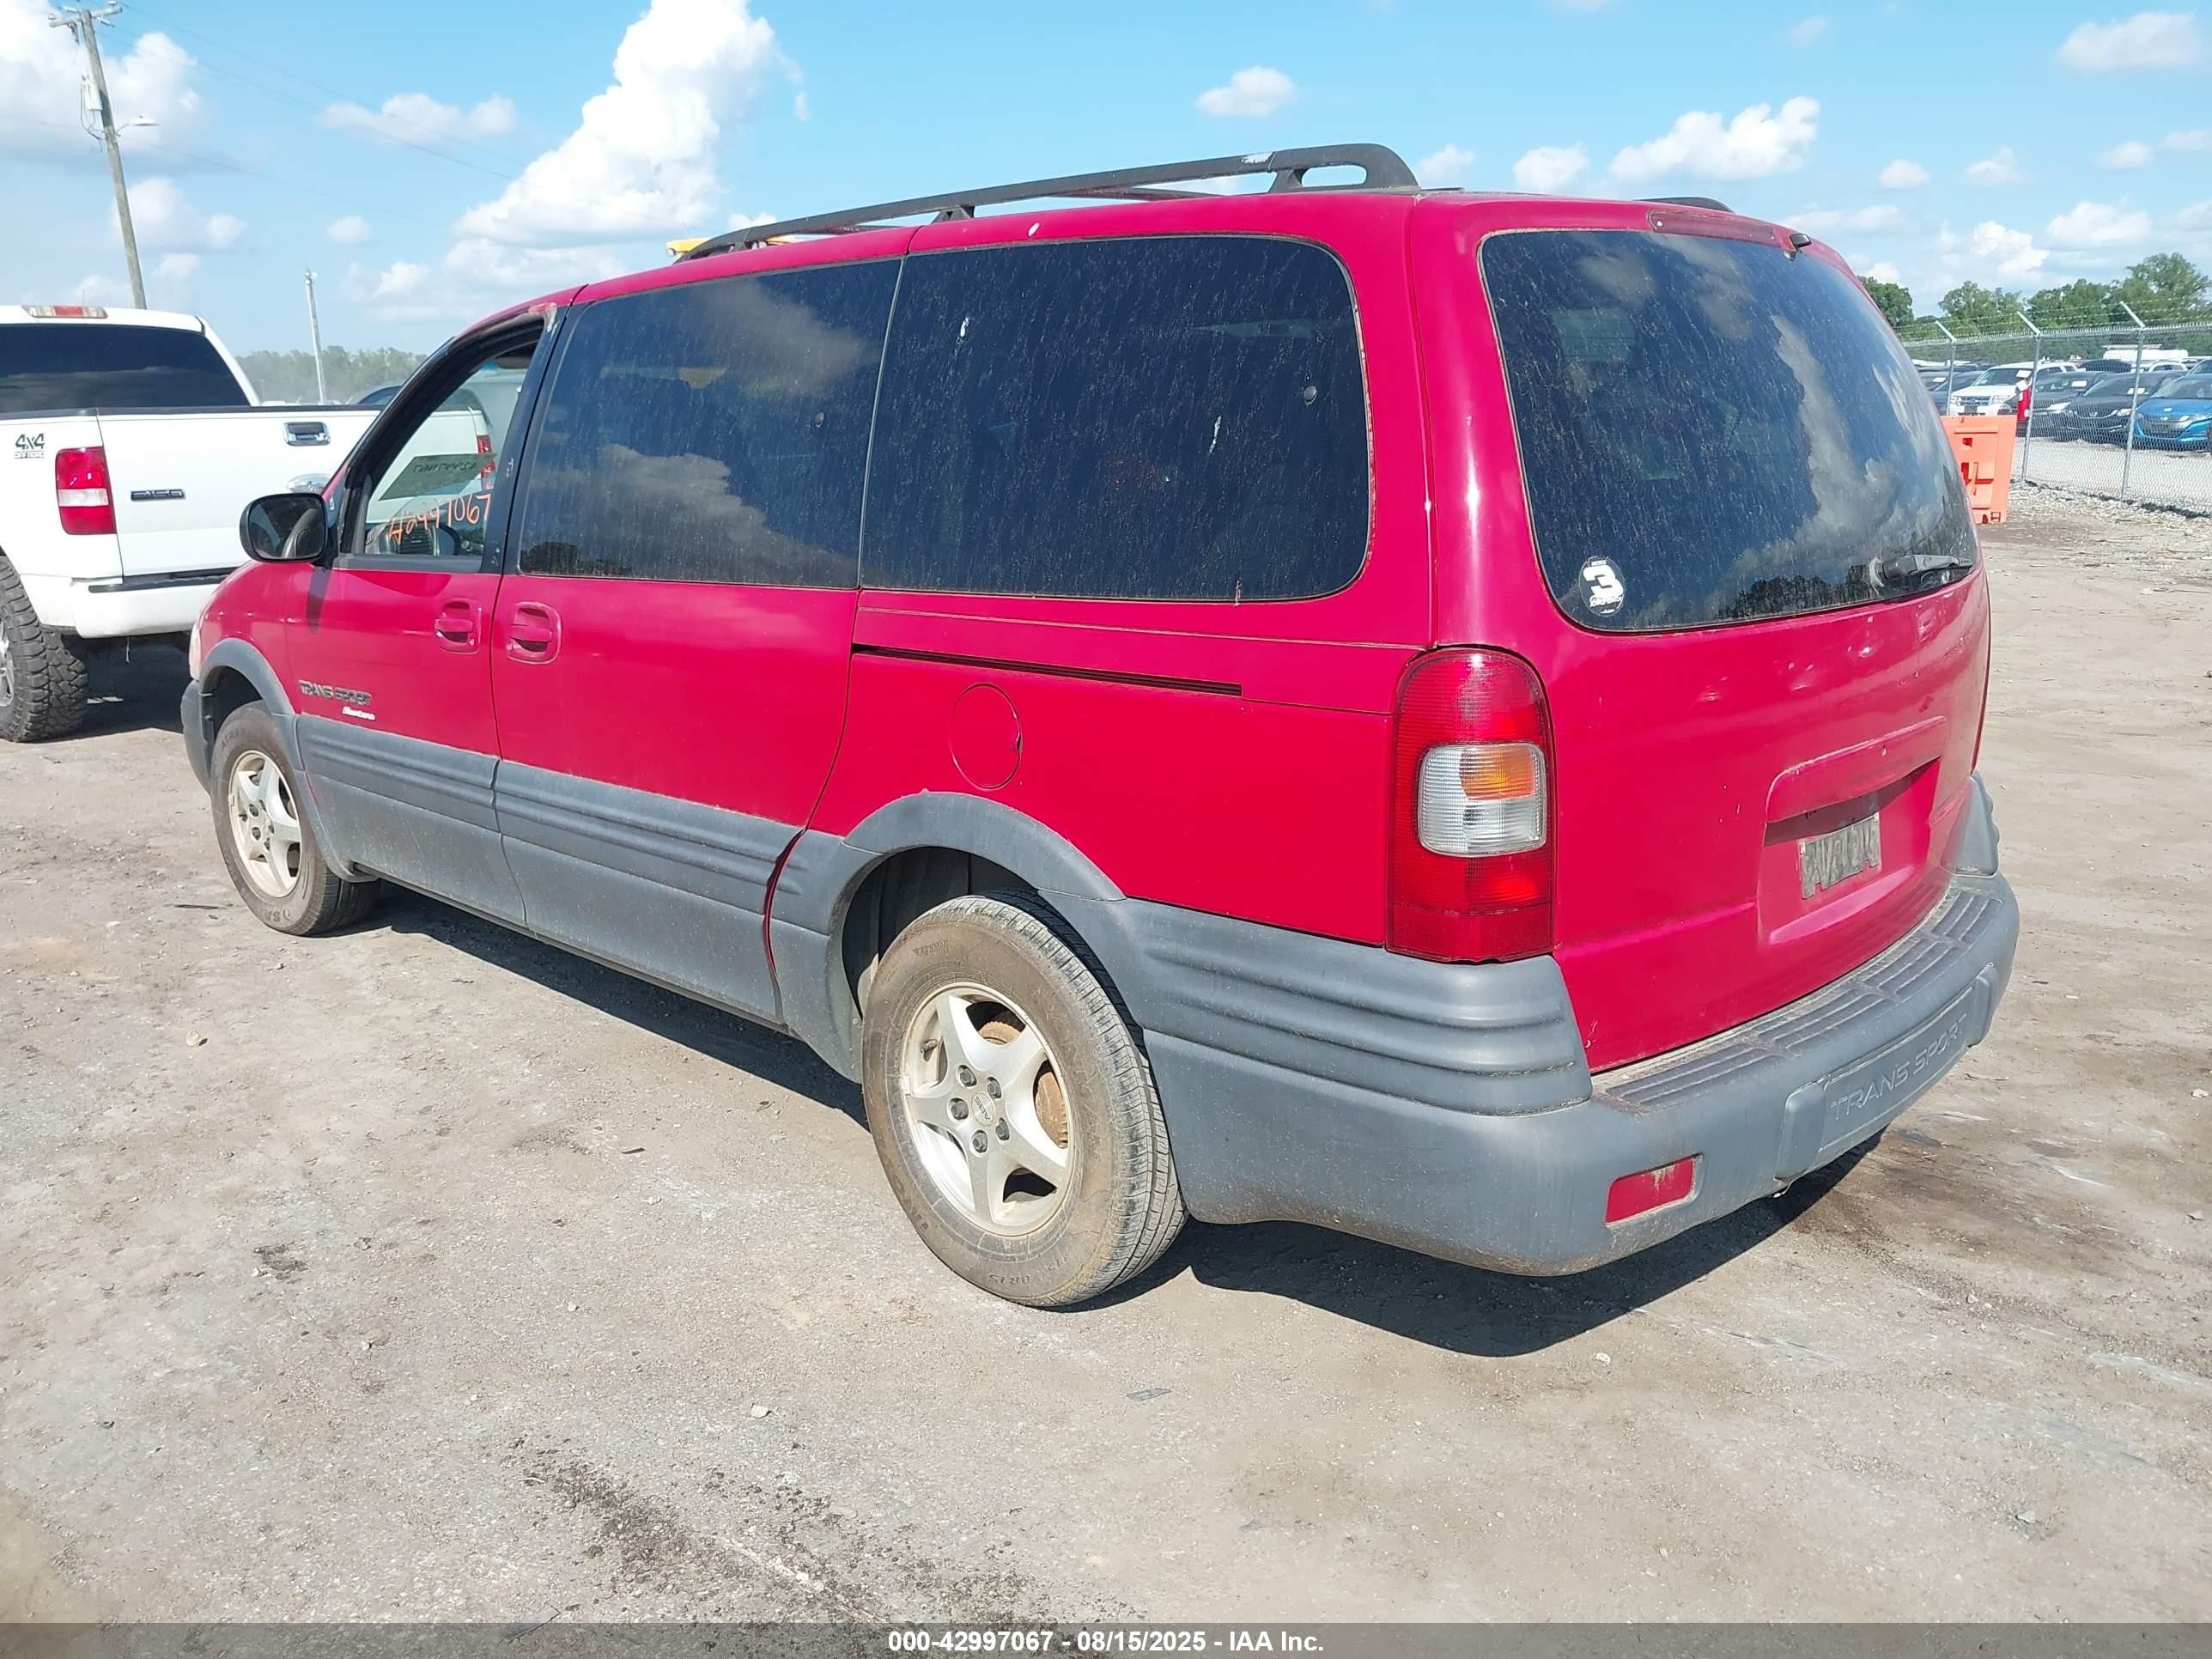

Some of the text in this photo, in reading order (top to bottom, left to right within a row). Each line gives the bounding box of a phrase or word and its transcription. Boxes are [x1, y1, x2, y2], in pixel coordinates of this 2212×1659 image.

[1583, 565, 1624, 600] 3
[298, 679, 372, 708] TRANS SPORT
[1830, 1012, 1967, 1121] TRANS SPORT
